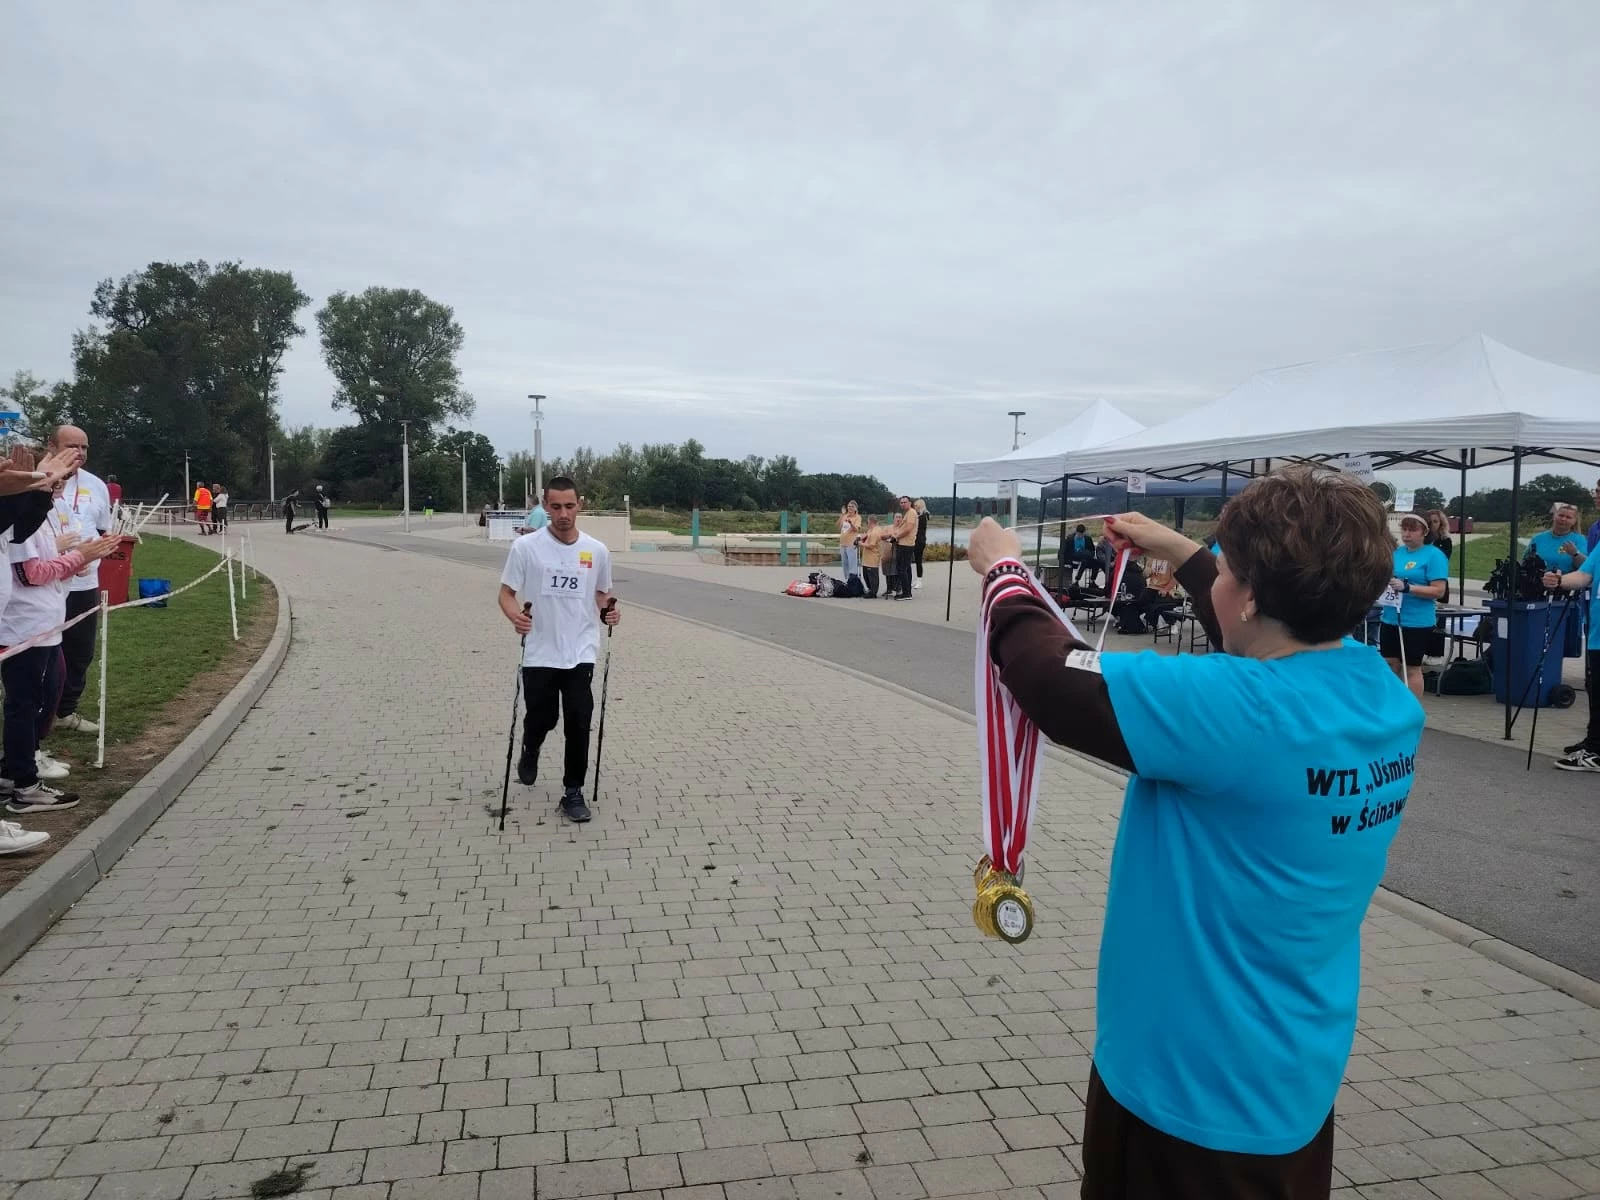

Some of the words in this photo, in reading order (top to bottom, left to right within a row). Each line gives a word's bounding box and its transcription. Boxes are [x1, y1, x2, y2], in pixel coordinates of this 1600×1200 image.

[550, 575, 578, 590] 178
[1306, 768, 1360, 796] WTZ
[1331, 815, 1351, 835] w
